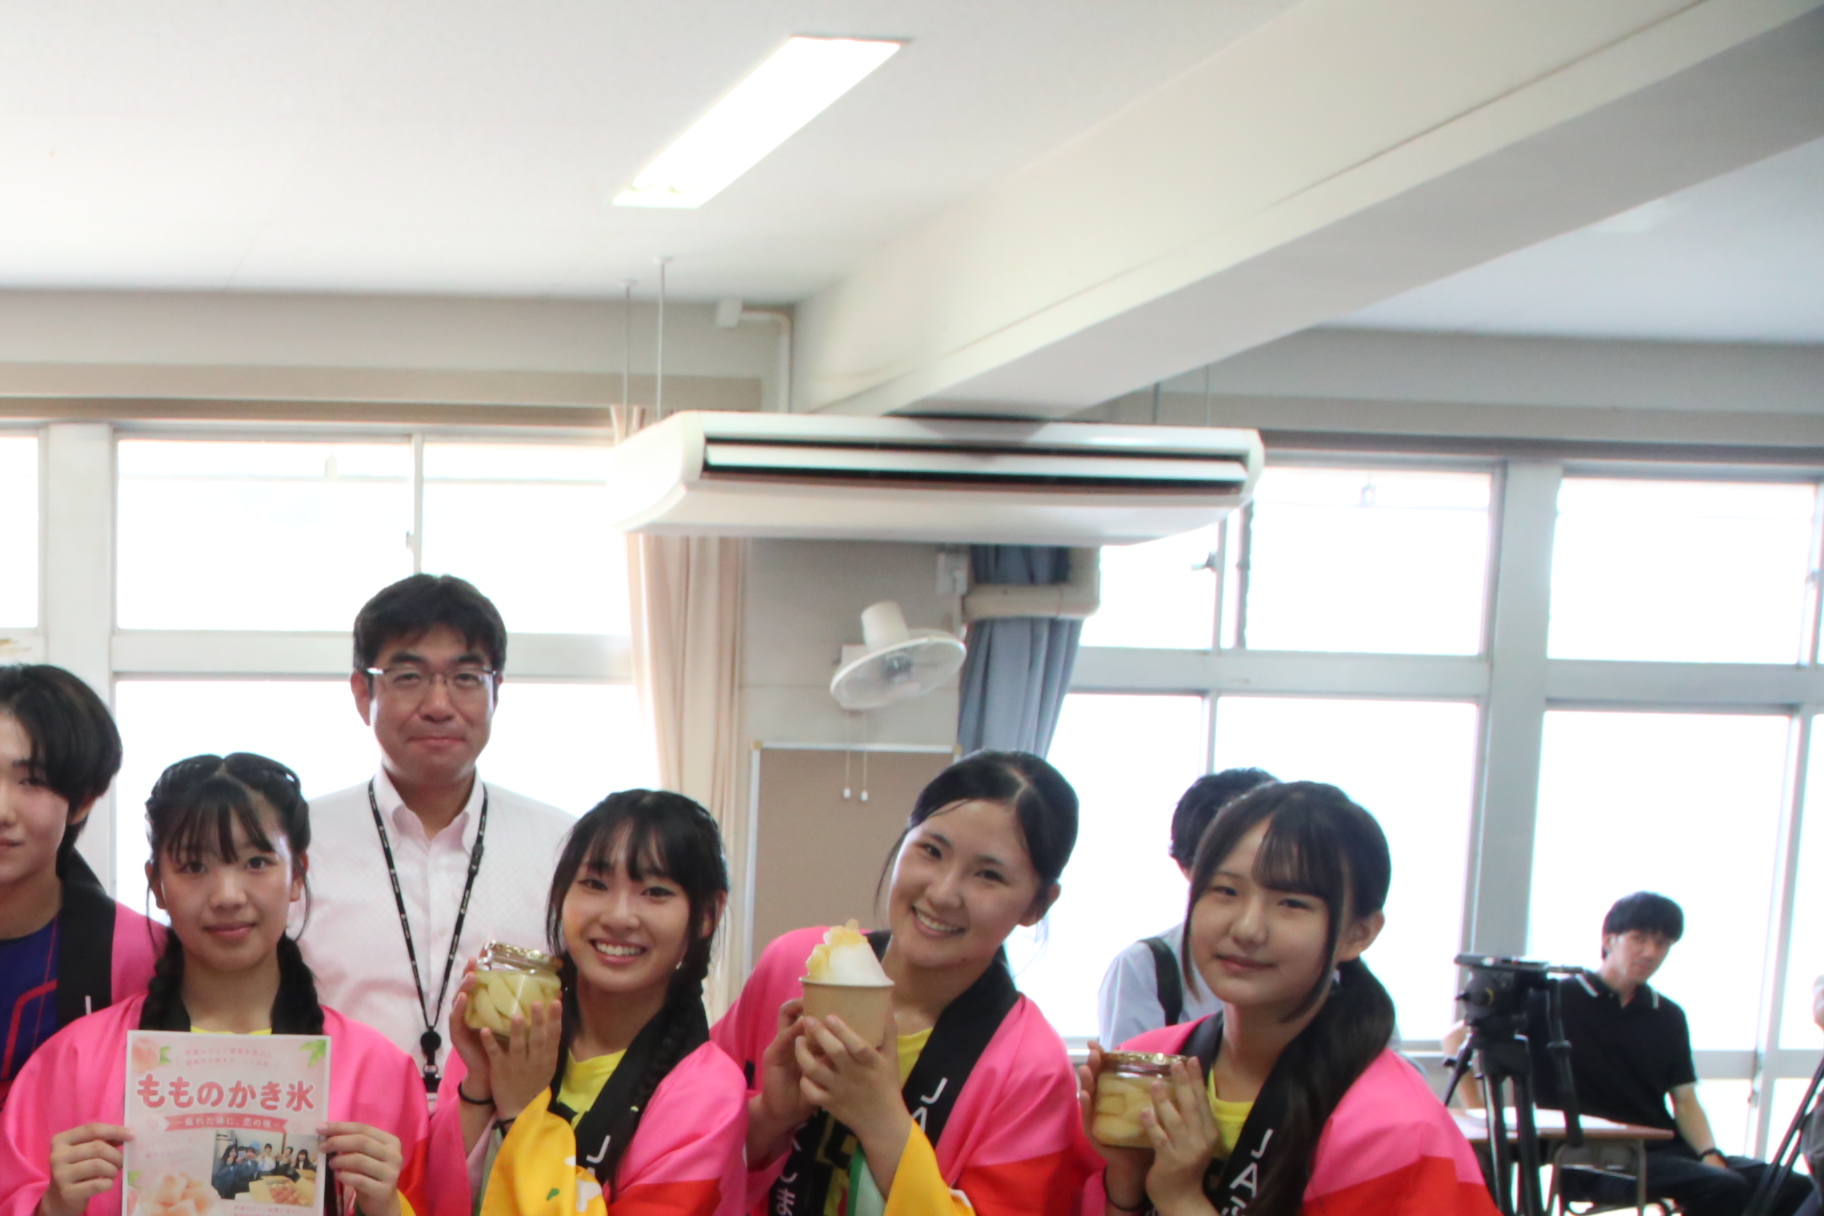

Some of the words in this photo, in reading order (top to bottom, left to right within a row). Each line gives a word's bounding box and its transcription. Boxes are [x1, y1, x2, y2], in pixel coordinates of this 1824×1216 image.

[137, 1074, 314, 1112] もものかき氷
